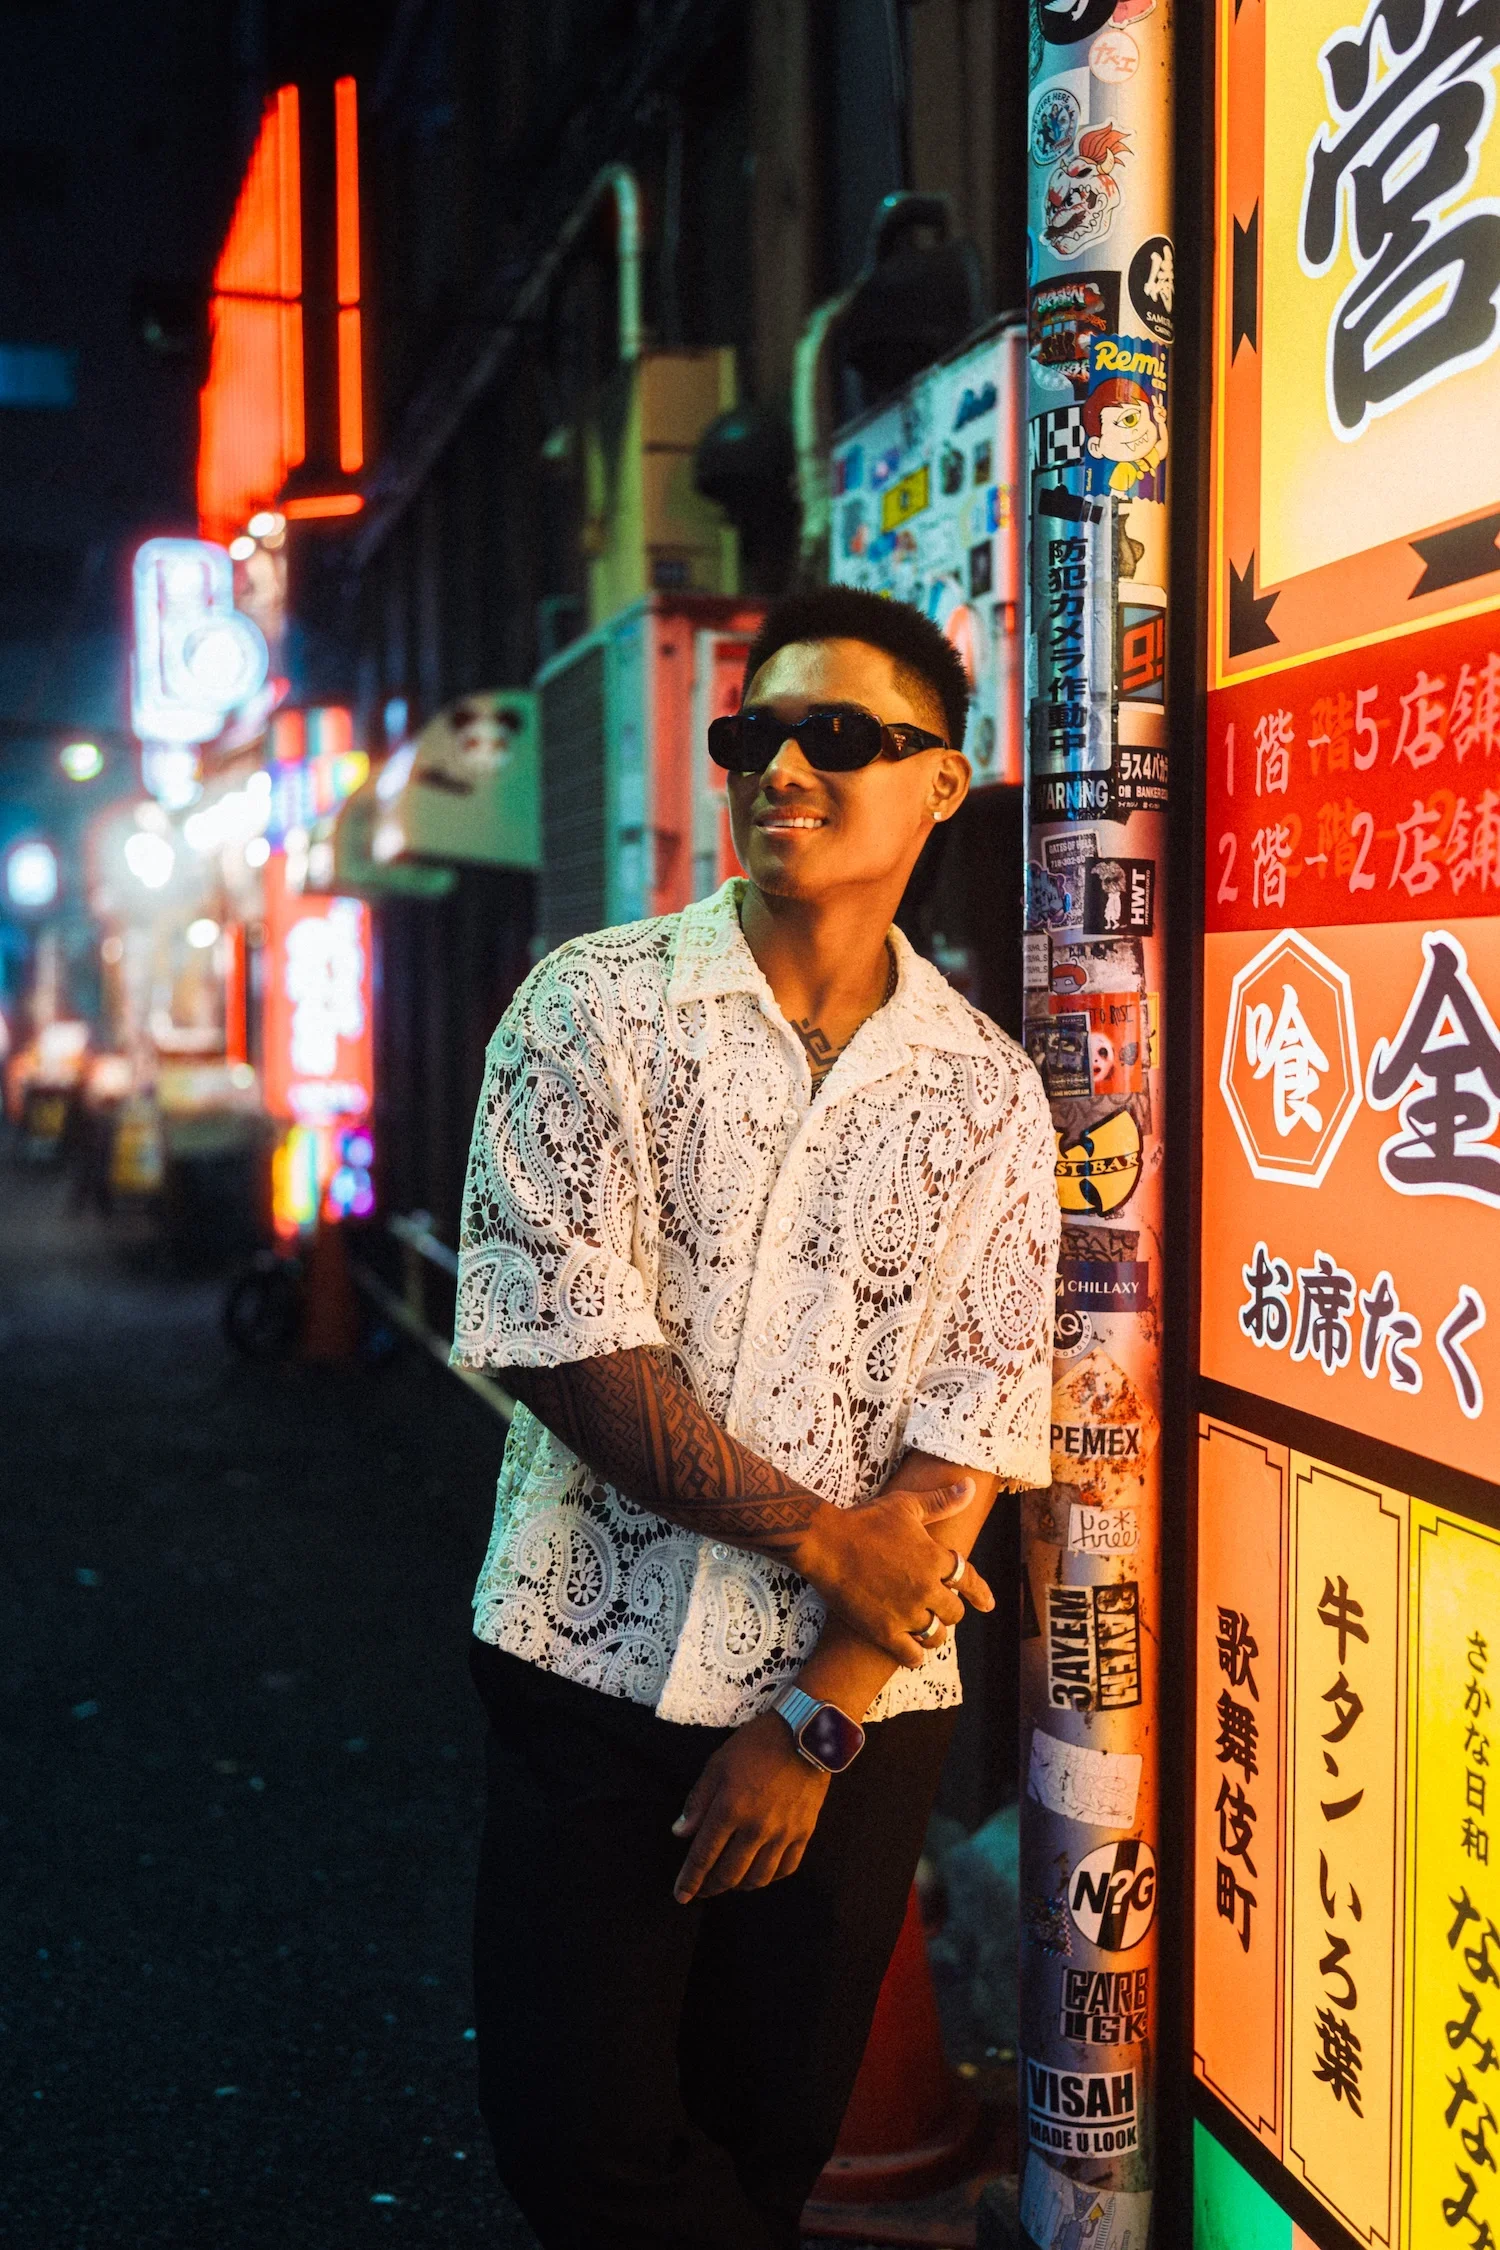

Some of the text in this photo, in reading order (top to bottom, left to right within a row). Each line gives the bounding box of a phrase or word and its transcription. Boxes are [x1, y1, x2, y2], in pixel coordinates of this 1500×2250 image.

[1036, 95, 1053, 116] WERE
[1053, 92, 1071, 103] HERE
[1094, 340, 1167, 380] Remi
[1047, 536, 1089, 757] 防犯カメラ作動中
[1131, 868, 1146, 925] HWT
[1091, 1152, 1140, 1175] BAR
[1067, 1280, 1140, 1294] CHILLAXY
[1240, 1242, 1486, 1418] お席たく
[1050, 1424, 1140, 1456] PEMEX
[1461, 1630, 1492, 1867] さかな日和
[1214, 1604, 1260, 1953] 歌舞伎町
[1028, 2062, 1134, 2118] VISAH
[1030, 2119, 1137, 2153] MADE U LOOK
